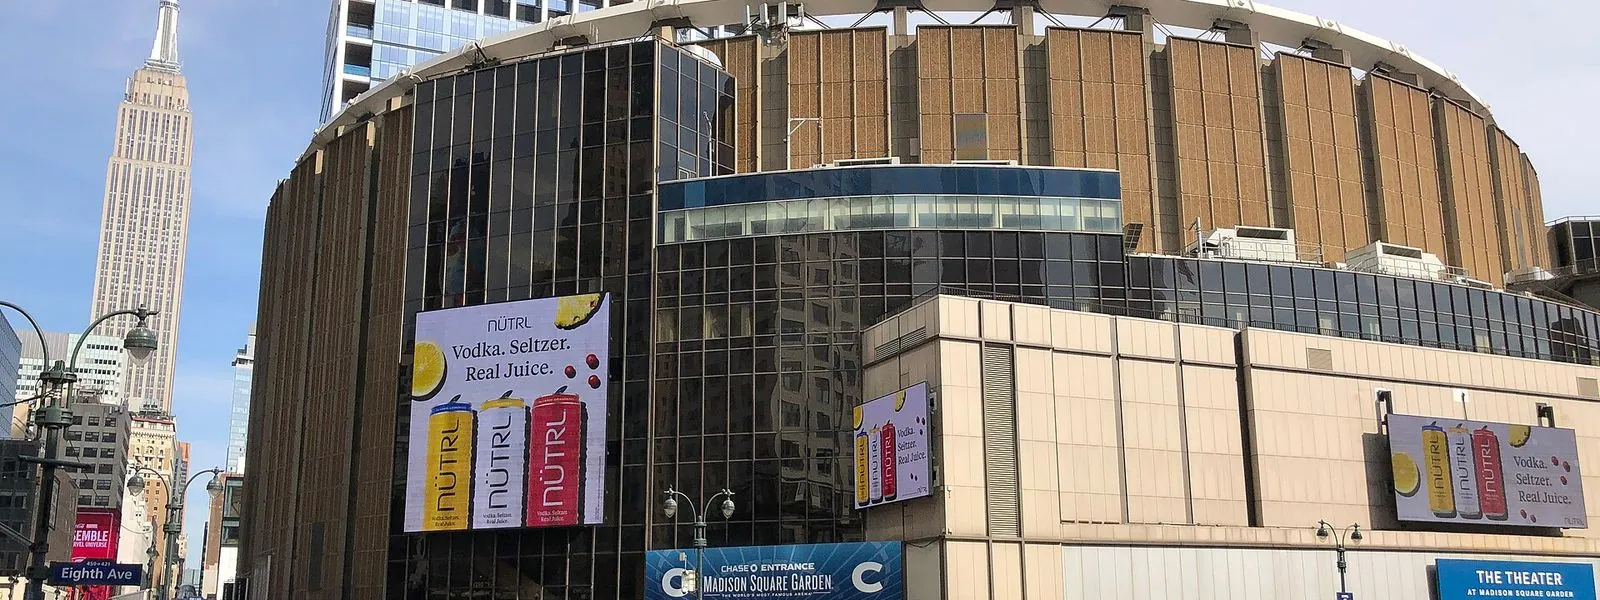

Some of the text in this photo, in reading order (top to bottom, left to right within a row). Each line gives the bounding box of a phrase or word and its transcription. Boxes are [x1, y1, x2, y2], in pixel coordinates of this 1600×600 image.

[452, 336, 571, 360] Vodka. Seltzer.
[465, 361, 553, 382] Real Juice.
[897, 426, 915, 438] Vodka.
[898, 454, 910, 465] Real
[1513, 455, 1548, 469] Vodka.
[1516, 473, 1553, 487] Seltzer.
[1518, 490, 1572, 505] Real Juice.
[61, 567, 133, 581] Eighth Ave
[720, 562, 815, 573] CHASE ENTRANCE
[703, 575, 747, 593] MADISON
[750, 574, 788, 592] SQUARE
[851, 561, 883, 593] C
[1476, 570, 1562, 585] THE THEATER
[1467, 588, 1476, 596] AT
[1515, 589, 1544, 597] SQUARE
